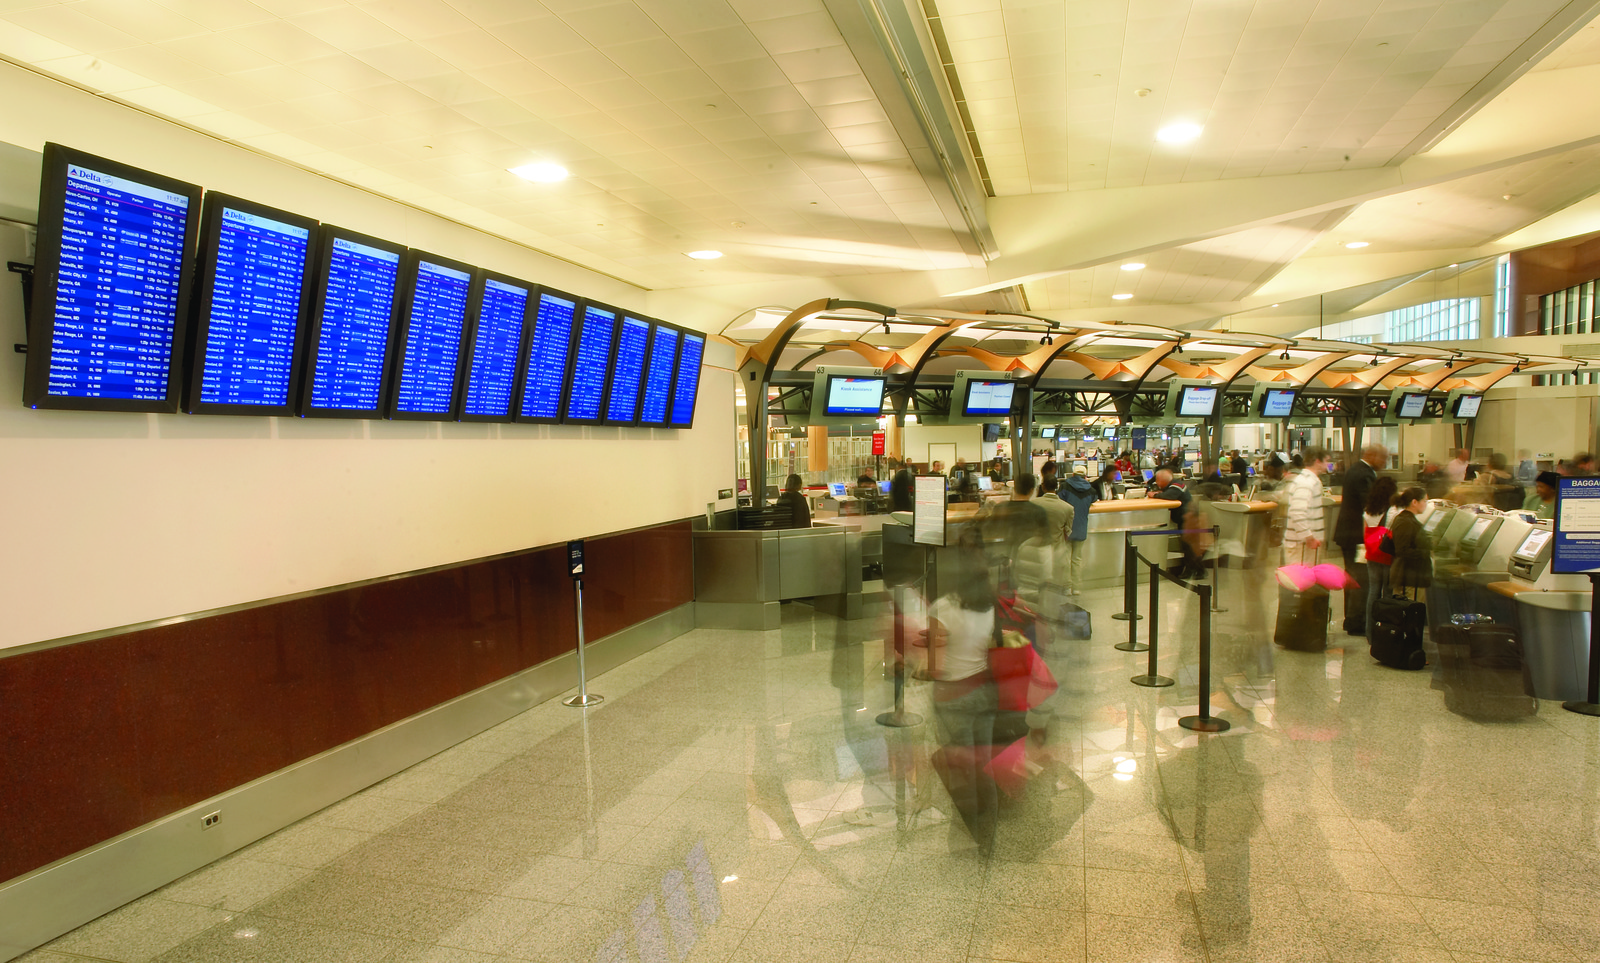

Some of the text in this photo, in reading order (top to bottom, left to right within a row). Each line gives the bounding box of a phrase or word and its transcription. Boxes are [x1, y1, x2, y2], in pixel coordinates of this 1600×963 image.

[80, 170, 101, 182] Delta
[68, 180, 100, 194] Departures
[230, 212, 246, 222] Delta
[222, 220, 244, 230] Departures
[340, 241, 350, 249] Delta
